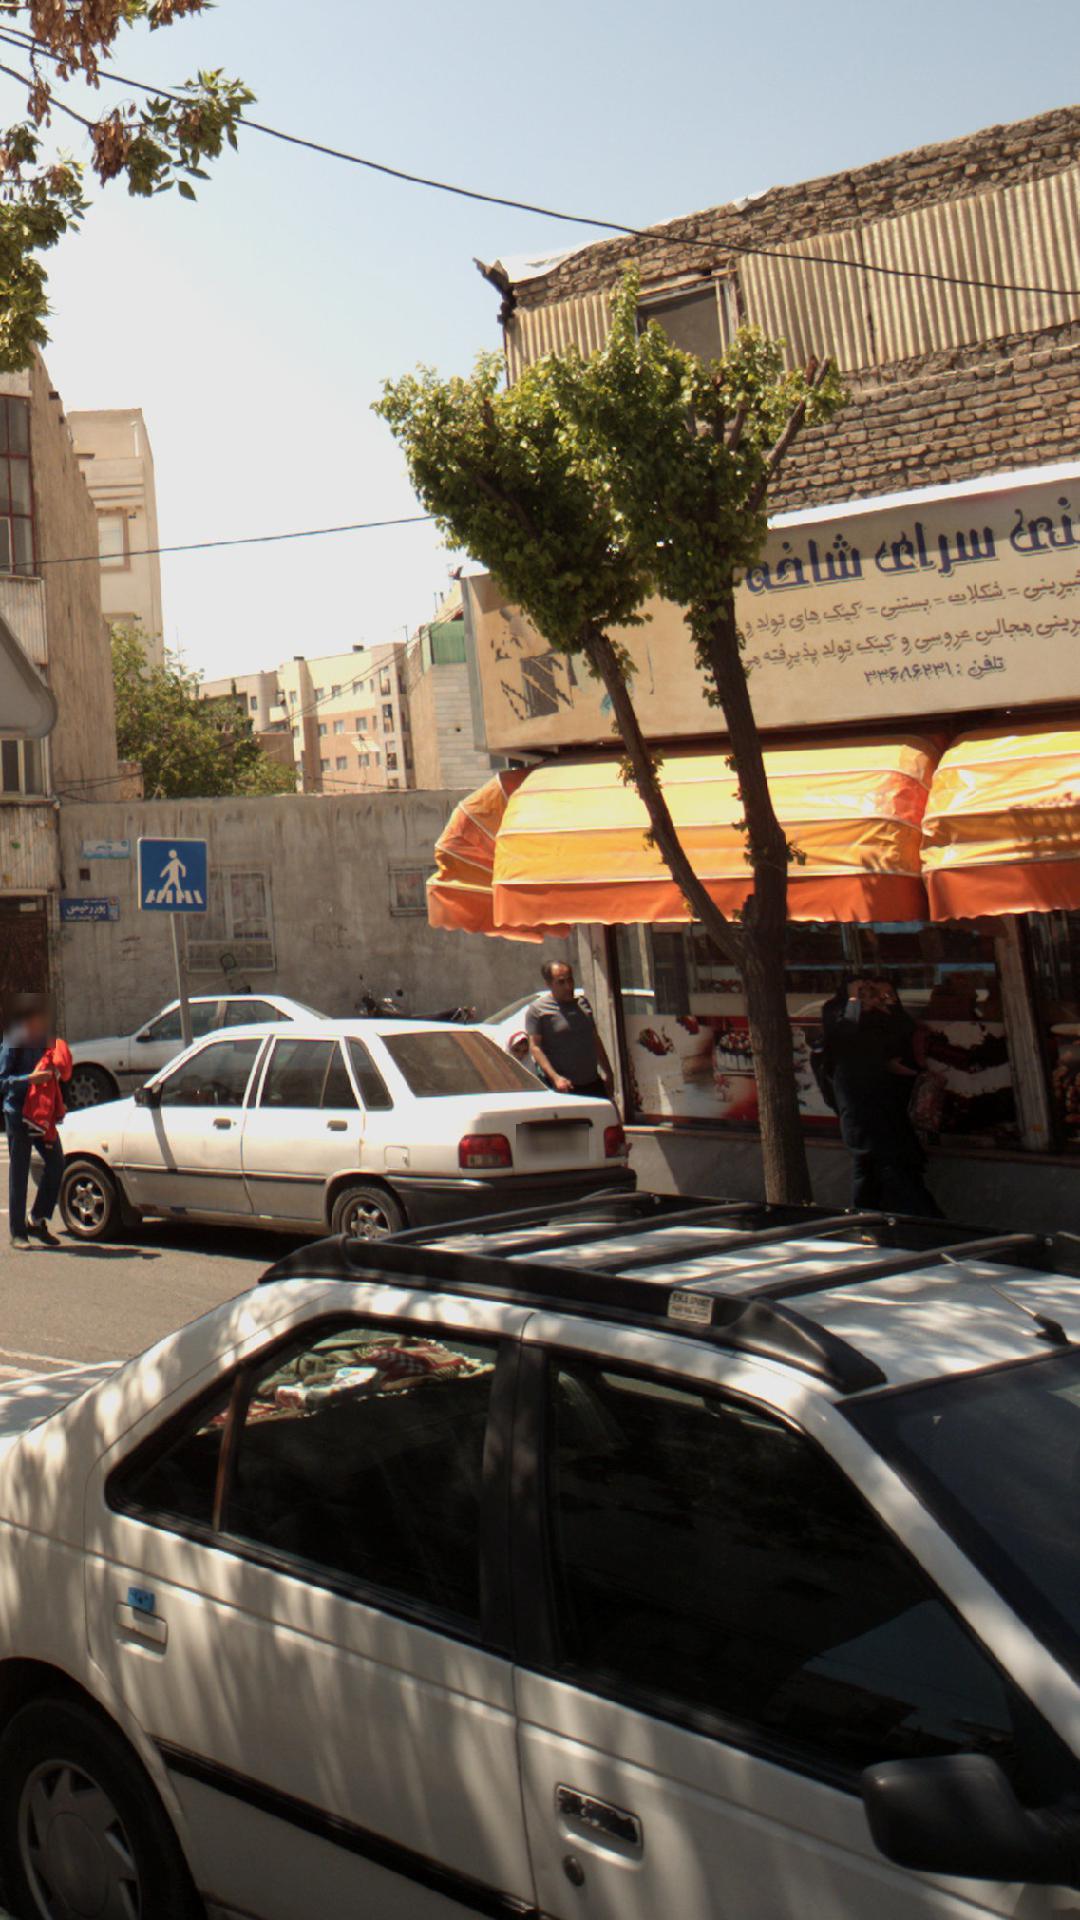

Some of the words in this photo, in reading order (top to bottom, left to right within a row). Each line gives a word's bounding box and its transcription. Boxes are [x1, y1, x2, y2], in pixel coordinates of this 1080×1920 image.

[874, 521, 996, 574] سرای
[823, 601, 862, 620] کیک
[880, 595, 930, 618] بستنی
[757, 612, 786, 635] تولد
[975, 617, 1032, 642] مجالس
[821, 639, 851, 662] تولد
[855, 633, 896, 653] کیک
[914, 629, 970, 650] عروسی
[763, 642, 818, 667] پذیرفته
[967, 654, 1005, 678] تلفن
